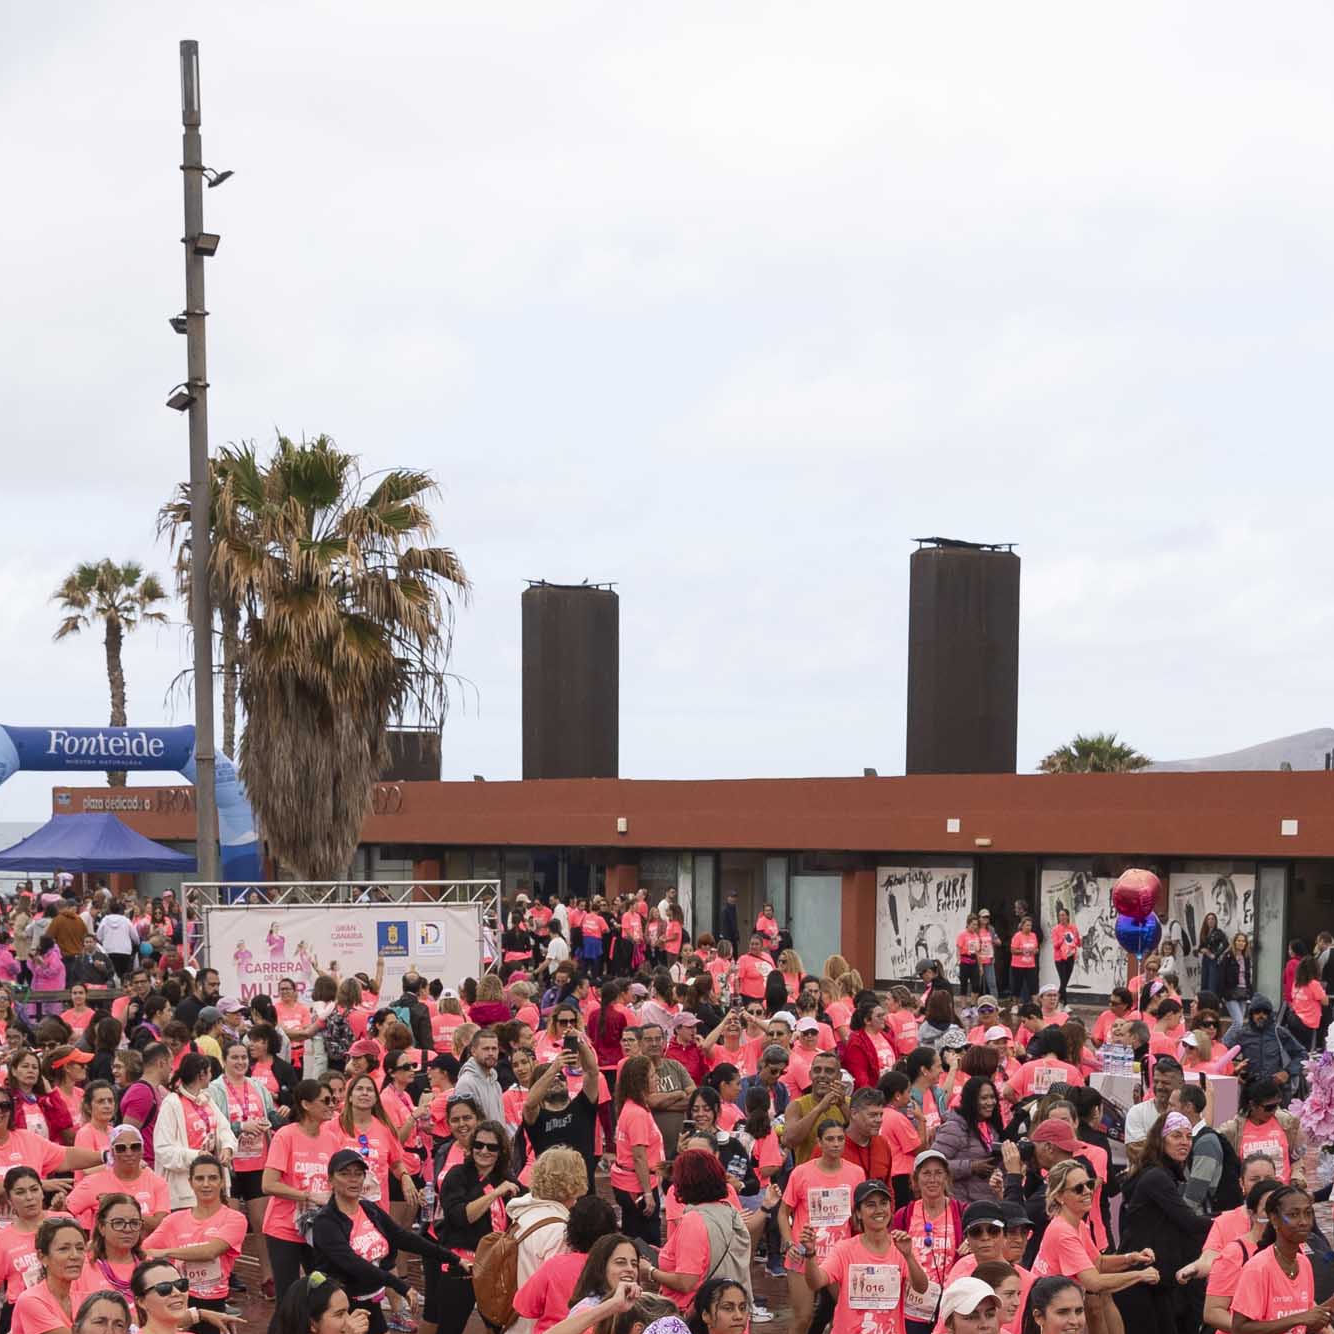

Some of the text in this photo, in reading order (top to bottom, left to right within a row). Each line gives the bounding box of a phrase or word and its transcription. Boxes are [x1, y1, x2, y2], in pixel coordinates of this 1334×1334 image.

[47, 730, 165, 757] Fonteide
[936, 873, 967, 899] PURA
[245, 962, 303, 974] CARRERA
[822, 1205, 839, 1213] 016
[188, 1269, 207, 1278] 016
[866, 1284, 884, 1293] 016
[907, 1294, 924, 1304] 016
